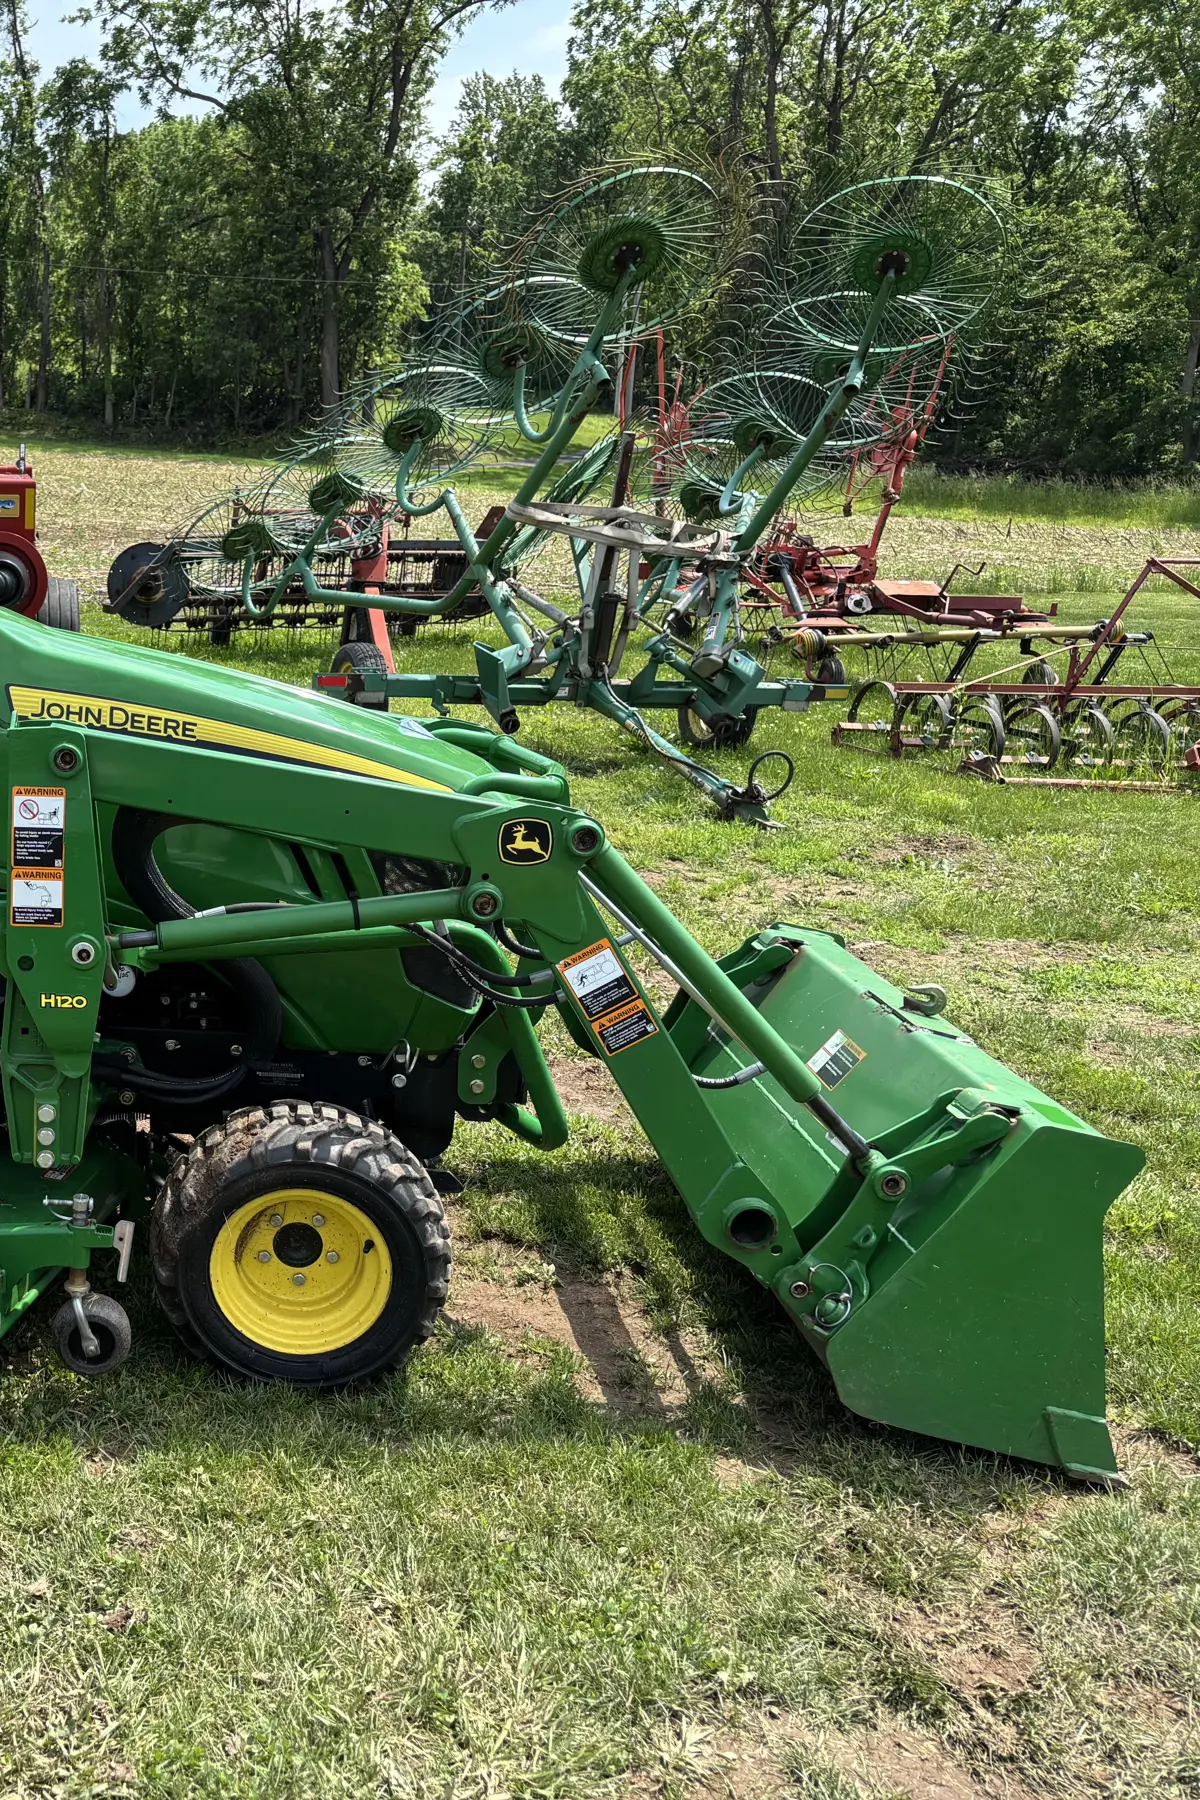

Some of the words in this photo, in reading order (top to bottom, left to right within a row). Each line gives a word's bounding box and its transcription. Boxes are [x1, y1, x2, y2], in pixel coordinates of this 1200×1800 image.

[31, 698, 102, 725] JOHN
[109, 706, 198, 739] DEERE
[23, 788, 64, 796] WARNING
[22, 871, 62, 880] WARNING
[571, 943, 604, 964] WARNING
[40, 993, 88, 1009] H120
[607, 1004, 640, 1024] WARNING
